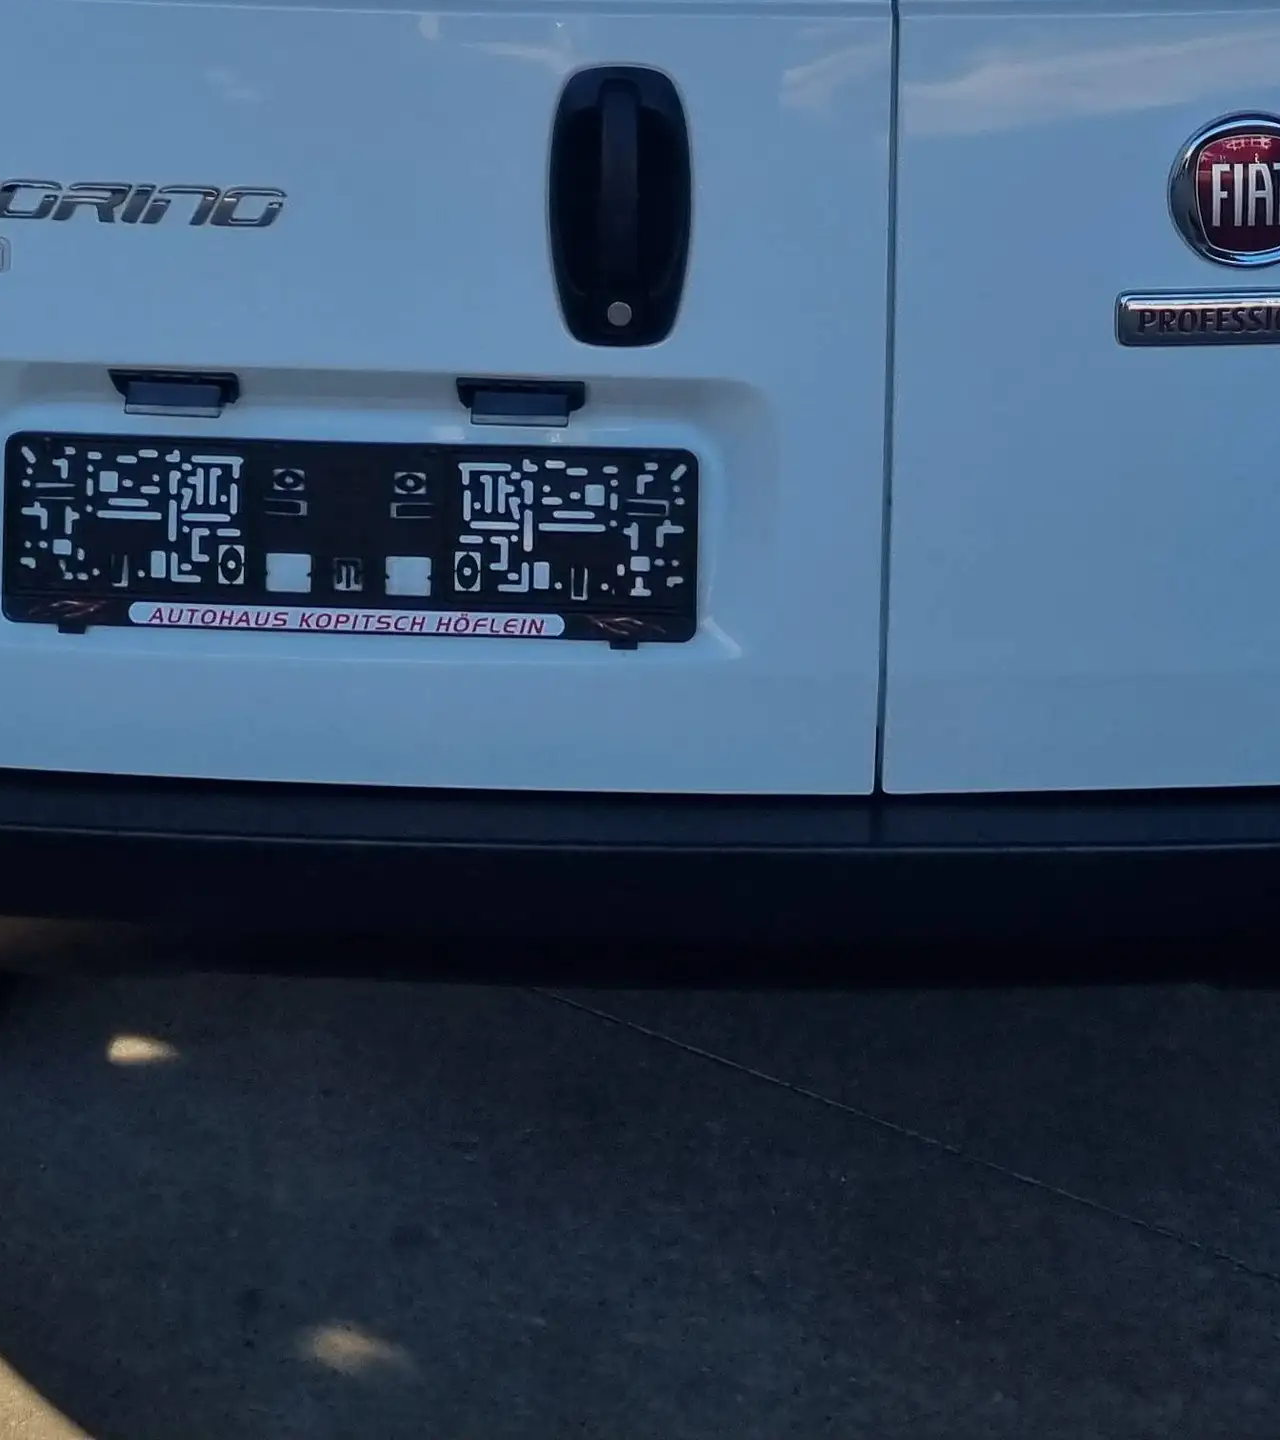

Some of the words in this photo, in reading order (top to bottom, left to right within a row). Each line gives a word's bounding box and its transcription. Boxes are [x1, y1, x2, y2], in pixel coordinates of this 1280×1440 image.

[148, 607, 290, 628] AUTOHAUS
[298, 611, 426, 632] KOPITSCH
[435, 613, 546, 635] HÖFLEIN
